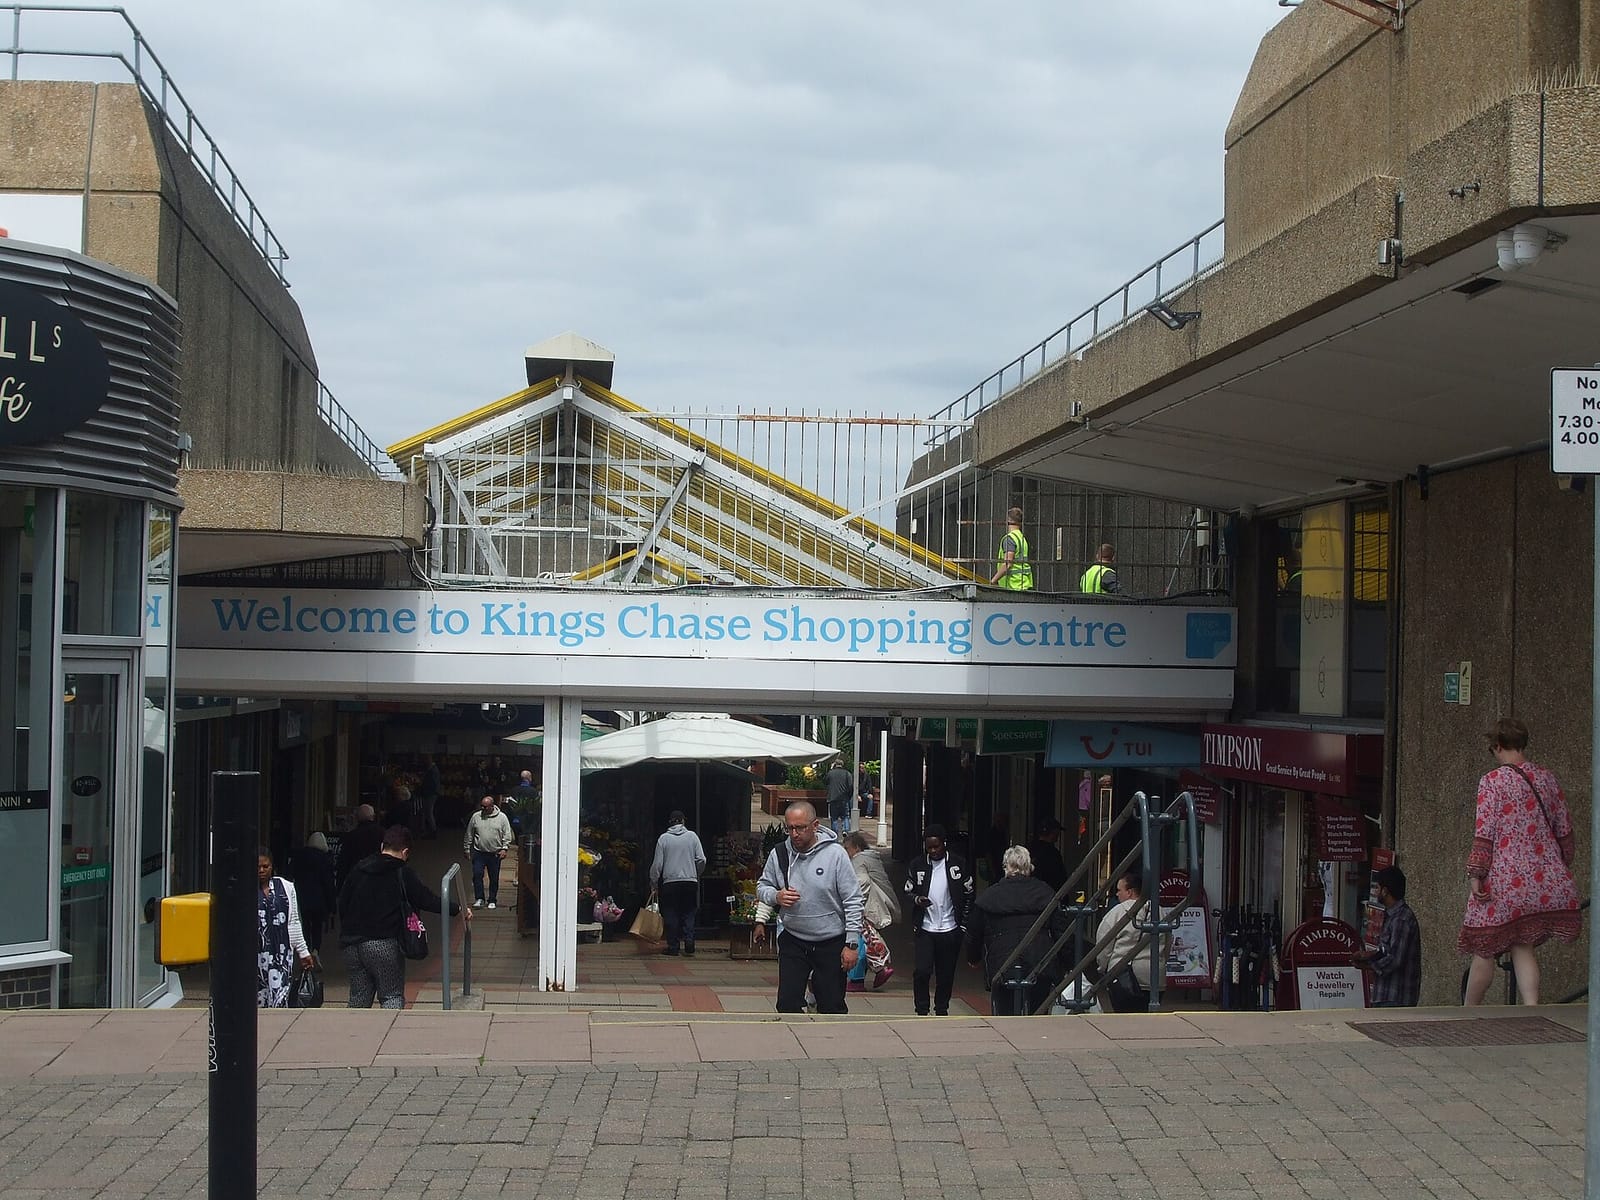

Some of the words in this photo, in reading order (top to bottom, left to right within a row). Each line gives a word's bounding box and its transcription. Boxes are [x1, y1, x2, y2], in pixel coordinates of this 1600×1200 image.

[1577, 376, 1598, 390] No
[1558, 415, 1593, 428] 7.30
[1560, 432, 1598, 445] 4.00
[212, 597, 417, 635] Welcome
[429, 604, 470, 637] to
[481, 601, 606, 648] Kings
[618, 602, 751, 641] Chase
[763, 605, 973, 656] Shopping
[983, 612, 1127, 648] Centre
[992, 729, 1044, 743] Specsavers
[1124, 742, 1152, 756] TUI
[1203, 732, 1263, 771] TIMPSON
[0, 795, 21, 808] NINI
[63, 870, 88, 884] EMERGENCY
[87, 869, 96, 880] EXIT
[96, 867, 106, 879] ONLY
[916, 871, 925, 886] F
[950, 865, 961, 880] C
[1159, 878, 1191, 891] IMPSO
[1300, 929, 1354, 948] TIMPSON
[1316, 971, 1345, 980] Watch
